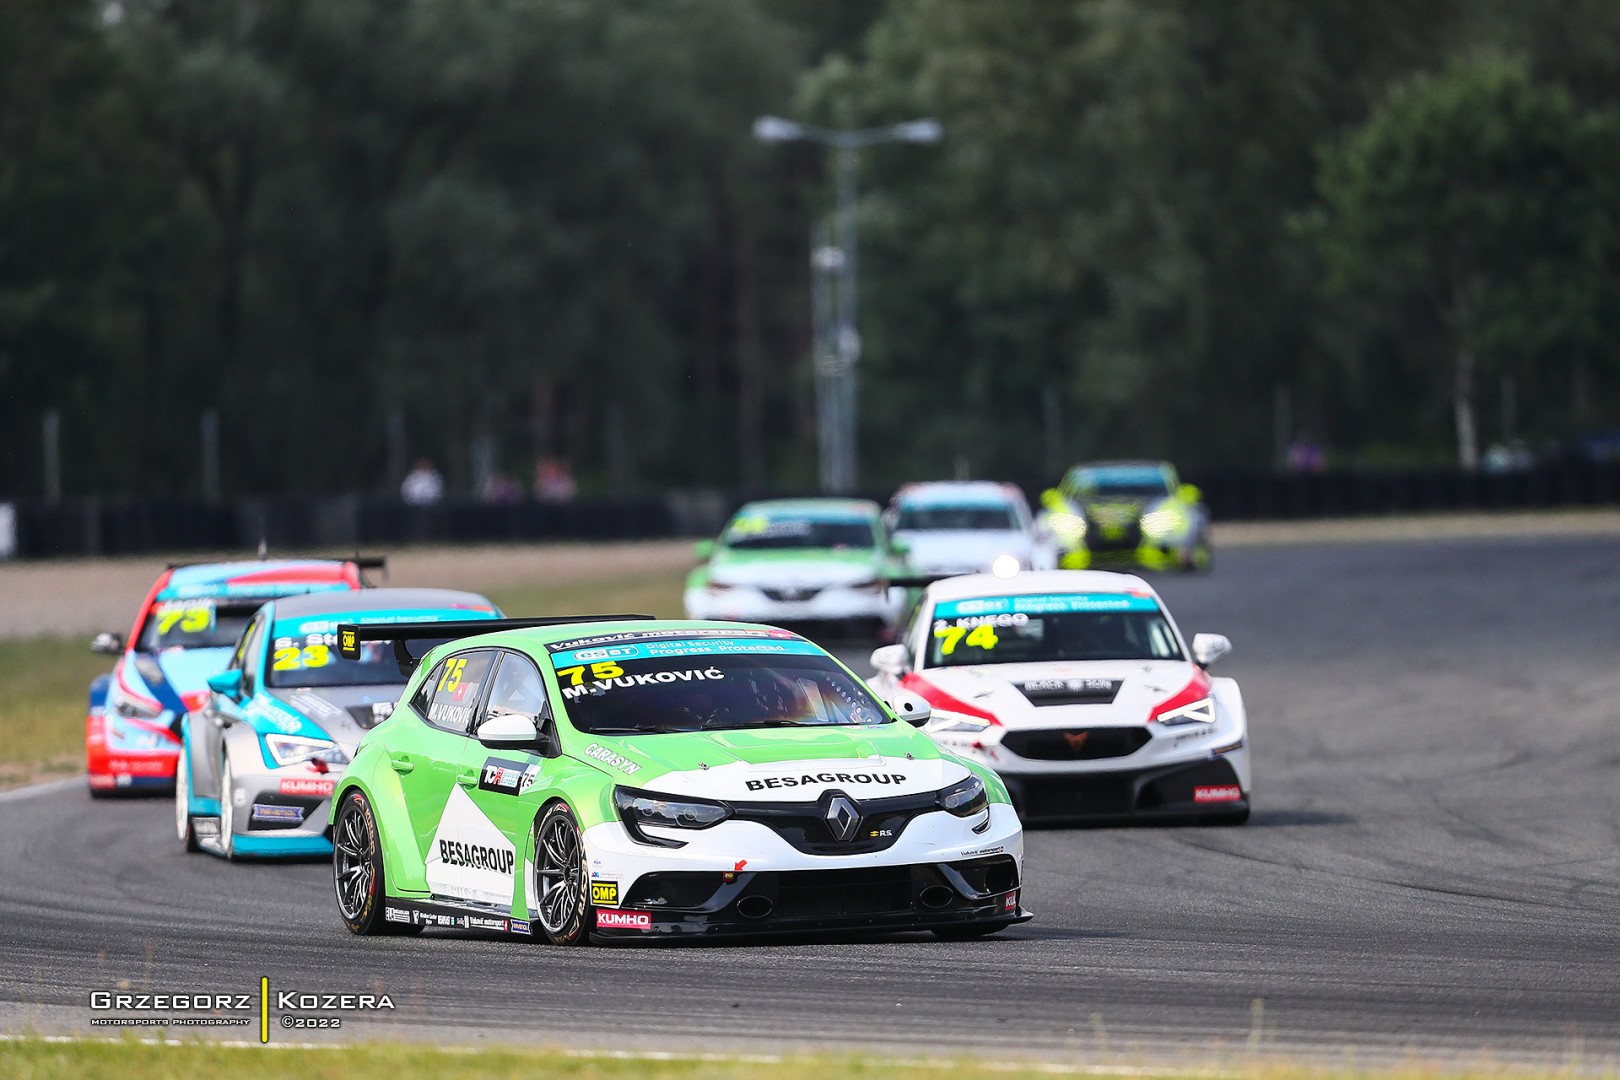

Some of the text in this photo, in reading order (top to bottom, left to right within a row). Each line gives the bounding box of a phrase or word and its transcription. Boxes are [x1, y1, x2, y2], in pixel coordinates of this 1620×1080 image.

[342, 634, 355, 648] OMP
[645, 639, 735, 650] Digital Security
[934, 624, 999, 656] 74
[273, 647, 329, 671] 23
[649, 644, 790, 656] Progress. Protected.
[437, 658, 468, 693] 75
[557, 660, 625, 687] 75
[484, 765, 504, 785] TCR
[521, 772, 535, 788] 75
[744, 772, 907, 792] BESAGROUP
[281, 780, 334, 792] KUMHO
[439, 838, 514, 875] BESAGROUP
[592, 886, 618, 901] OMP
[597, 913, 649, 925] KUMHO
